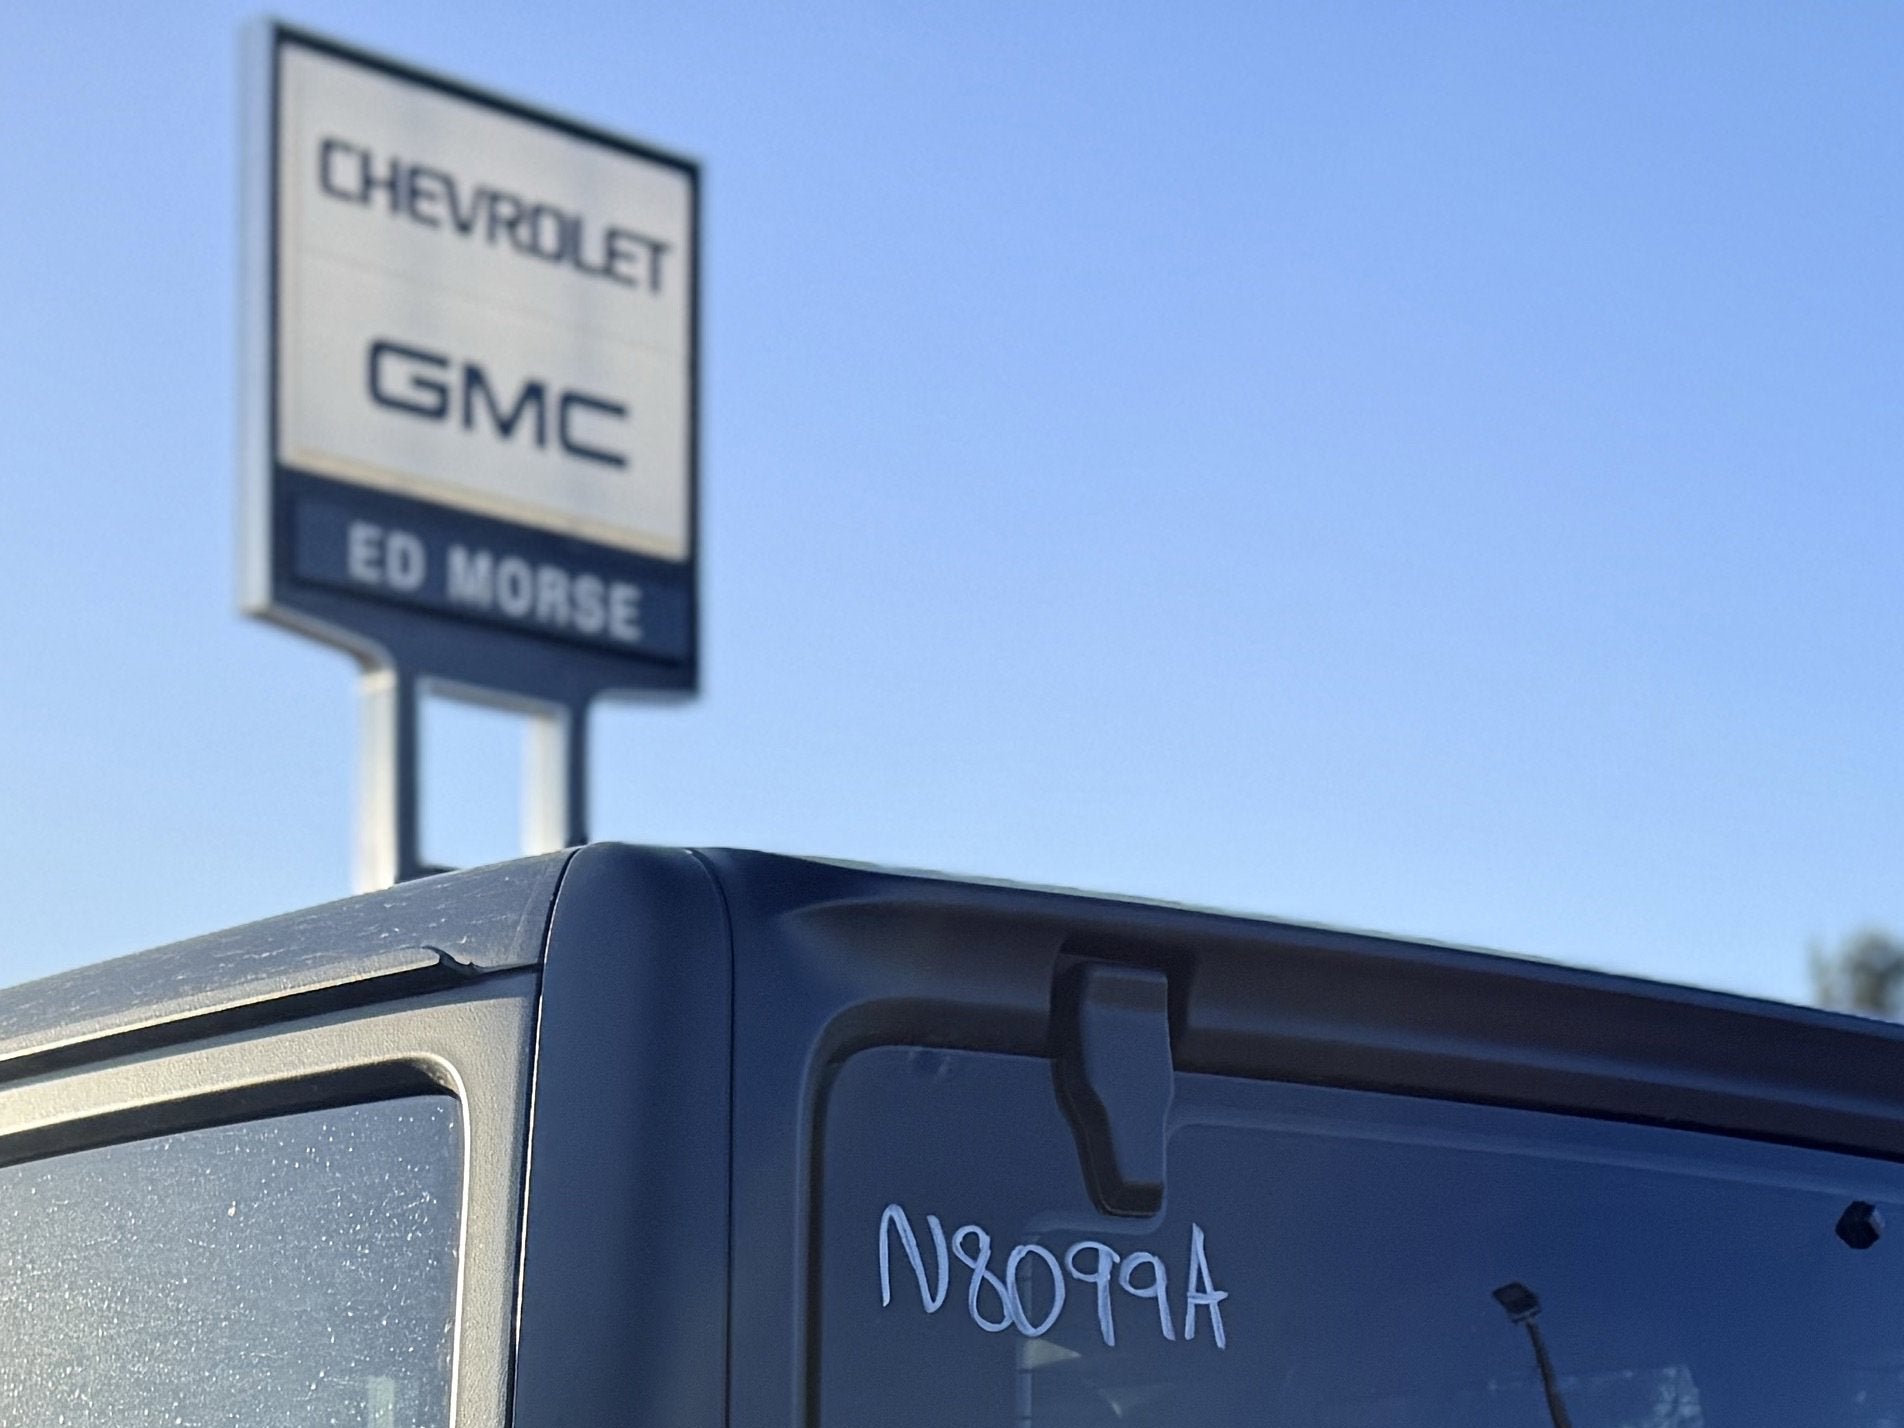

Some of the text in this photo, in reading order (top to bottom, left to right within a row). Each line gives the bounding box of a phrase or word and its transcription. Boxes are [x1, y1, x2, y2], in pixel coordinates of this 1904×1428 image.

[319, 136, 673, 295] CHEVROLET
[366, 338, 632, 470] GMC
[347, 520, 644, 643] ED MORSE
[879, 1203, 1229, 1350] N8099A
